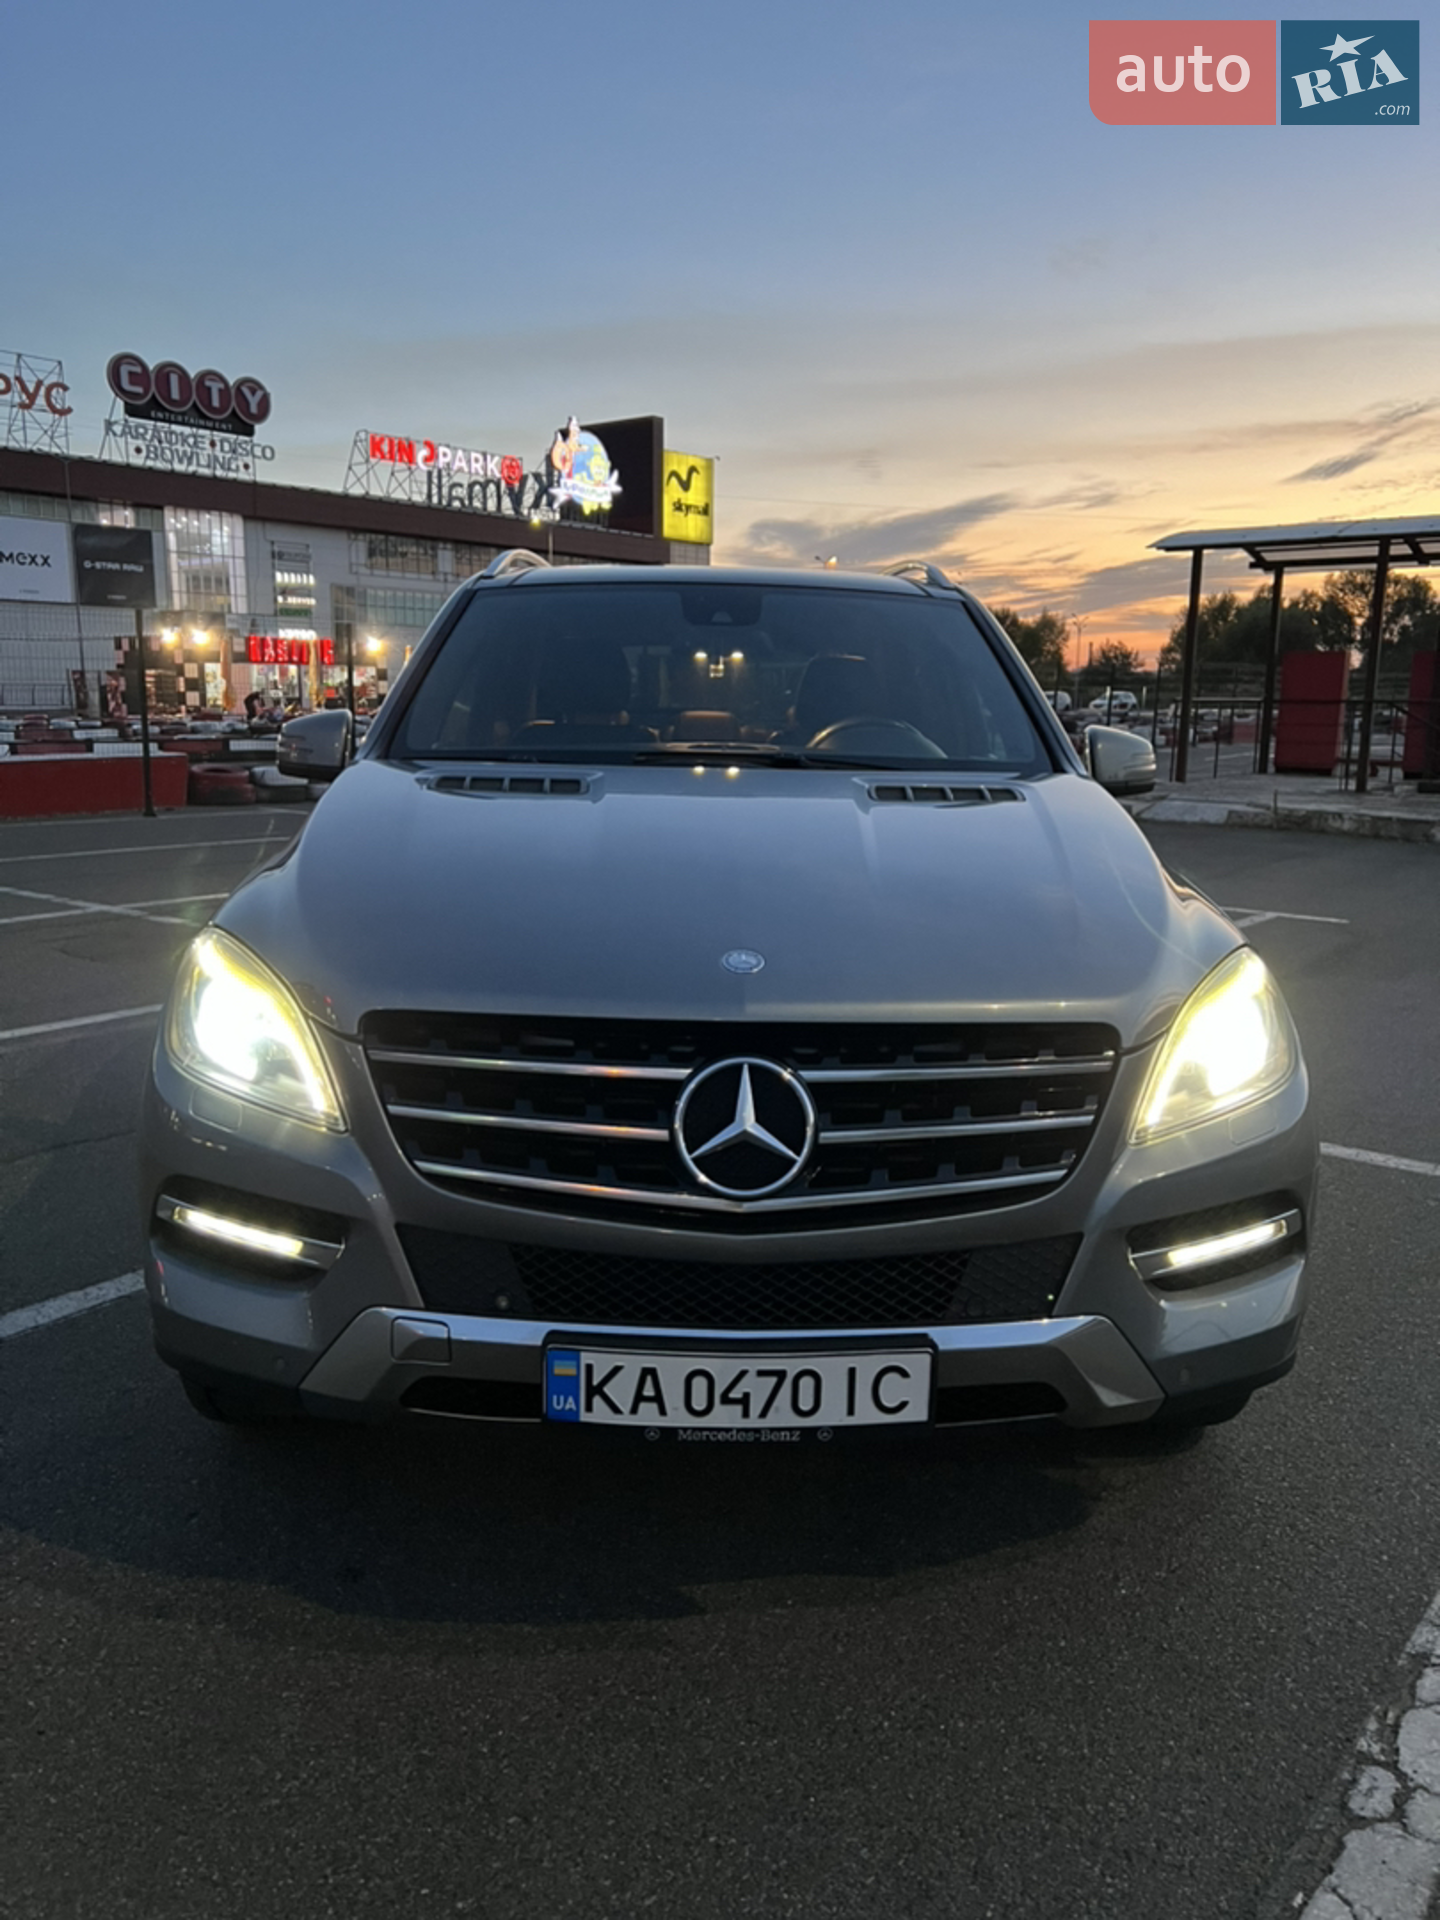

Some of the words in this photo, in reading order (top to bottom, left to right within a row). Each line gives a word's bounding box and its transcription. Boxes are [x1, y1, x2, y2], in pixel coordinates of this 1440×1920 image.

[119, 361, 265, 416] CITY
[150, 410, 233, 431] ENTERTAINMENT
[104, 419, 207, 451] KARAOKE
[220, 437, 275, 461] DISCO
[145, 444, 240, 472] BOWLING
[672, 497, 710, 518] skymall
[552, 1394, 577, 1411] UA
[584, 1363, 668, 1417] KA
[684, 1367, 823, 1419] 0470
[846, 1364, 912, 1416] IC
[677, 1428, 802, 1443] Mercedes-Benz
